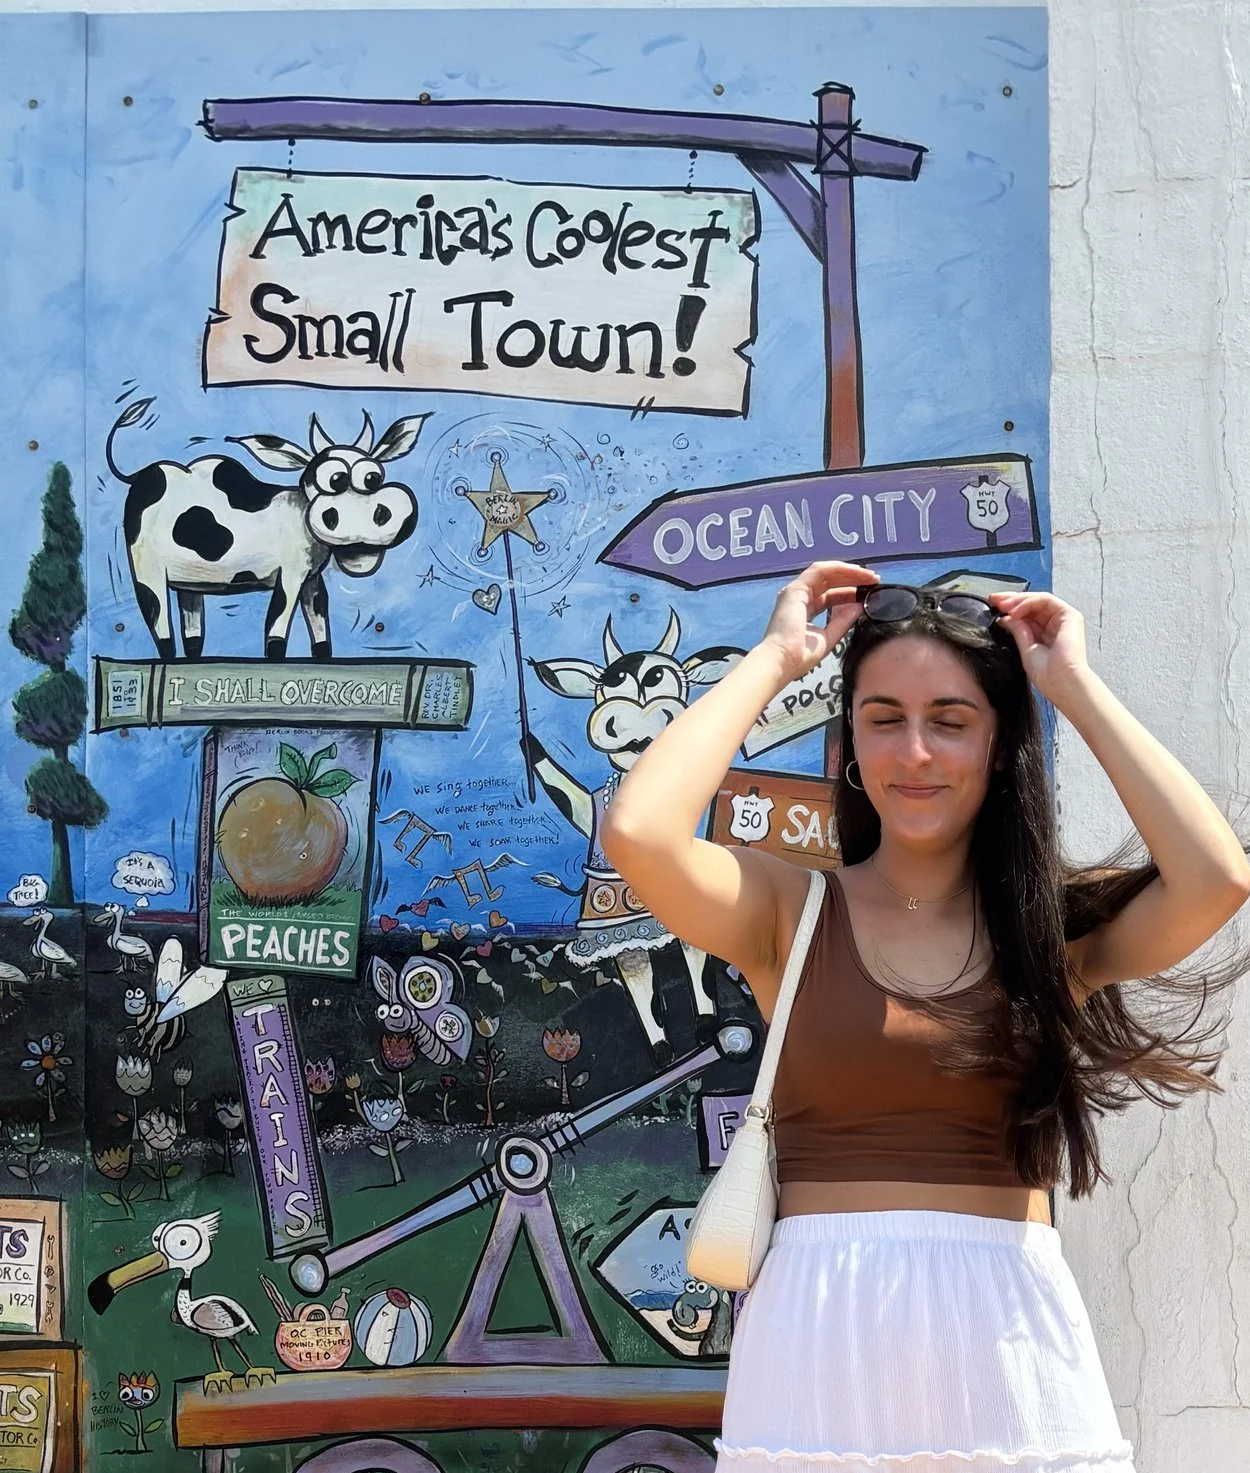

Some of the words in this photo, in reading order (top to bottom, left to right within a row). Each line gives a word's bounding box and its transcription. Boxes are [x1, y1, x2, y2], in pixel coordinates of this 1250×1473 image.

[250, 193, 513, 266] America's
[526, 200, 731, 289] Coolest
[243, 282, 417, 374] Small
[444, 289, 706, 380] Town!
[485, 493, 519, 507] BERLIN
[977, 499, 999, 518] 50
[653, 498, 815, 566] OCEAN
[828, 488, 936, 546] CITY
[193, 677, 277, 706] SHALL
[279, 678, 403, 708] OVERCOME
[413, 785, 431, 796] WE
[434, 805, 451, 815] WE
[457, 821, 471, 831] WE
[739, 809, 762, 829] 50
[468, 839, 482, 848] WE
[147, 861, 155, 870] A
[221, 908, 242, 917] THE
[220, 923, 351, 967] PEACHES
[232, 982, 255, 997] WE
[241, 1003, 312, 1239] TRAINS
[8, 1292, 35, 1308] 1929
[314, 1326, 344, 1338] PIER
[279, 1339, 315, 1350] MOVING
[298, 1351, 332, 1363] 1910
[91, 1405, 124, 1416] BERLIN
